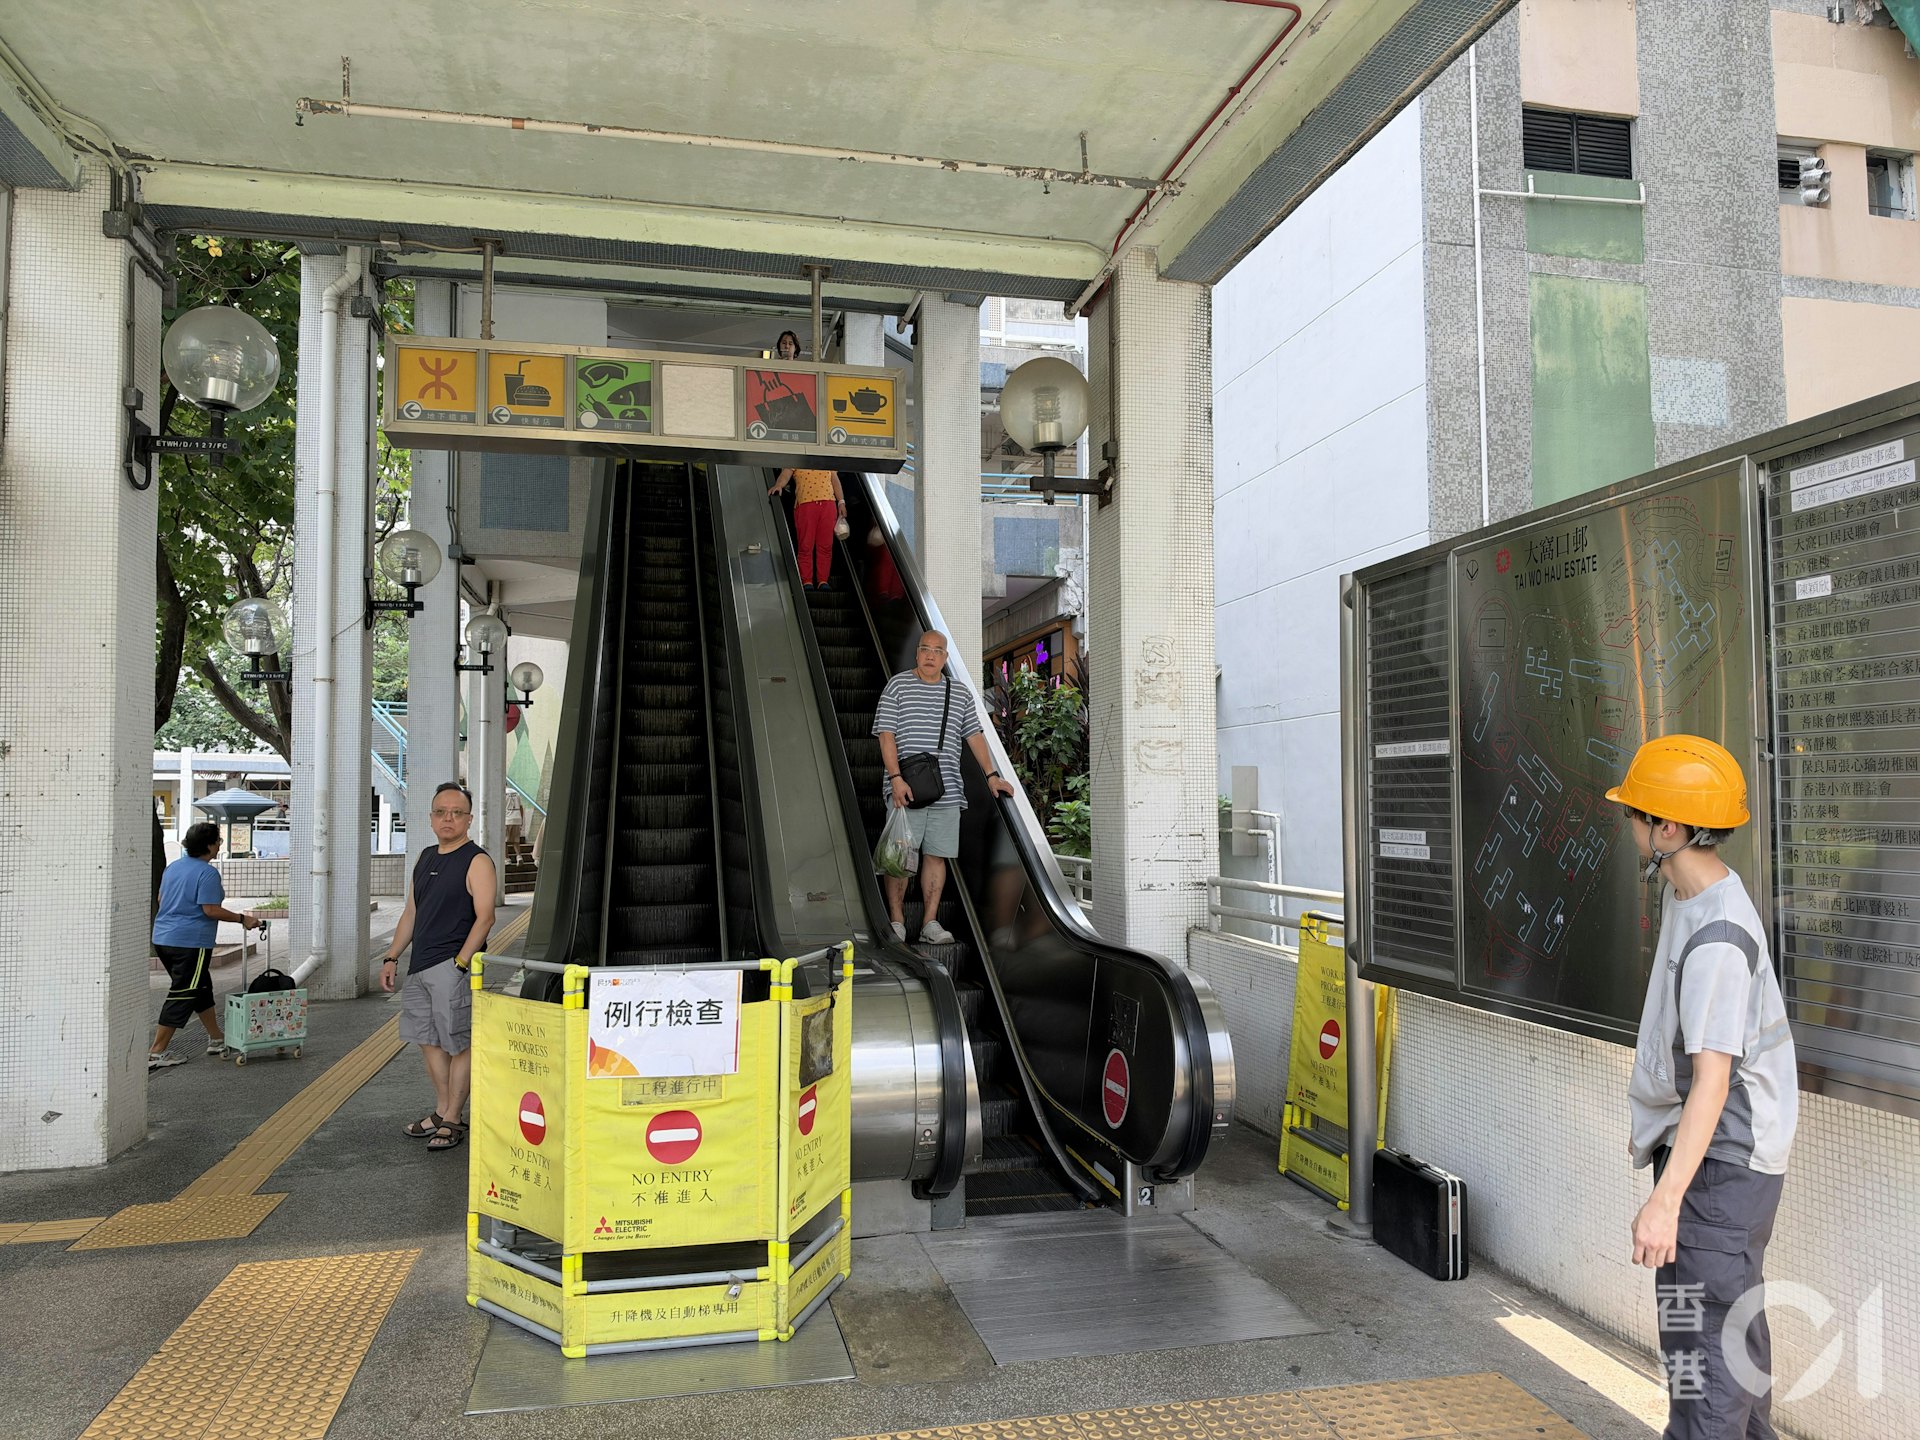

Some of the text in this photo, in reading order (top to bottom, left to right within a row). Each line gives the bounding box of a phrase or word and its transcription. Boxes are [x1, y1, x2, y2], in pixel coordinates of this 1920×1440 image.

[426, 412, 469, 421] 地下鐵路
[521, 417, 551, 426] 快餐店
[614, 422, 633, 430] 街市
[781, 433, 800, 441] 商場
[851, 437, 888, 446] 中式酒樓
[1795, 445, 1898, 485] 伍景華區議員辦事處
[1797, 466, 1910, 507] 葵青區下大窩口關愛隊
[1794, 521, 1881, 553] 大窩口居民聯會
[1524, 525, 1588, 569] 大窩口邨
[1514, 573, 1527, 591] TAI
[1528, 568, 1542, 588] WO
[1544, 563, 1562, 584] HAU
[1564, 554, 1598, 579] ESTATE
[1797, 617, 1871, 641] 香港肌健協會
[1798, 646, 1834, 663] 富逸樓
[1799, 691, 1836, 708] 富平樓
[1802, 756, 1919, 774] 保良局張心瑜幼稚園
[1803, 780, 1891, 797] 香港小童群益會
[1803, 804, 1840, 819] 富泰樓
[1804, 849, 1841, 865] 富賢樓
[1805, 871, 1841, 888] 協康會
[1806, 895, 1910, 917] 葵涌西北區賢毅社
[1806, 917, 1843, 935] 富德樓
[604, 998, 723, 1029] 例行檢查
[505, 1021, 546, 1038] WORK IN
[508, 1039, 549, 1058] PROGRESS
[510, 1058, 550, 1078] 工程進行中
[635, 1077, 717, 1096] 工程進行中
[795, 1134, 824, 1163] NO ENTRY
[509, 1145, 551, 1171] NO ENTRY
[508, 1163, 552, 1191] 不准進入
[631, 1169, 713, 1186] NO ENTRY
[631, 1188, 714, 1207] 不准進入
[1139, 1187, 1151, 1206] 2
[615, 1218, 653, 1226] MITSUBISHI
[615, 1225, 648, 1233] ELECTRIC
[611, 1302, 739, 1324] 升降機及自動梯專用
